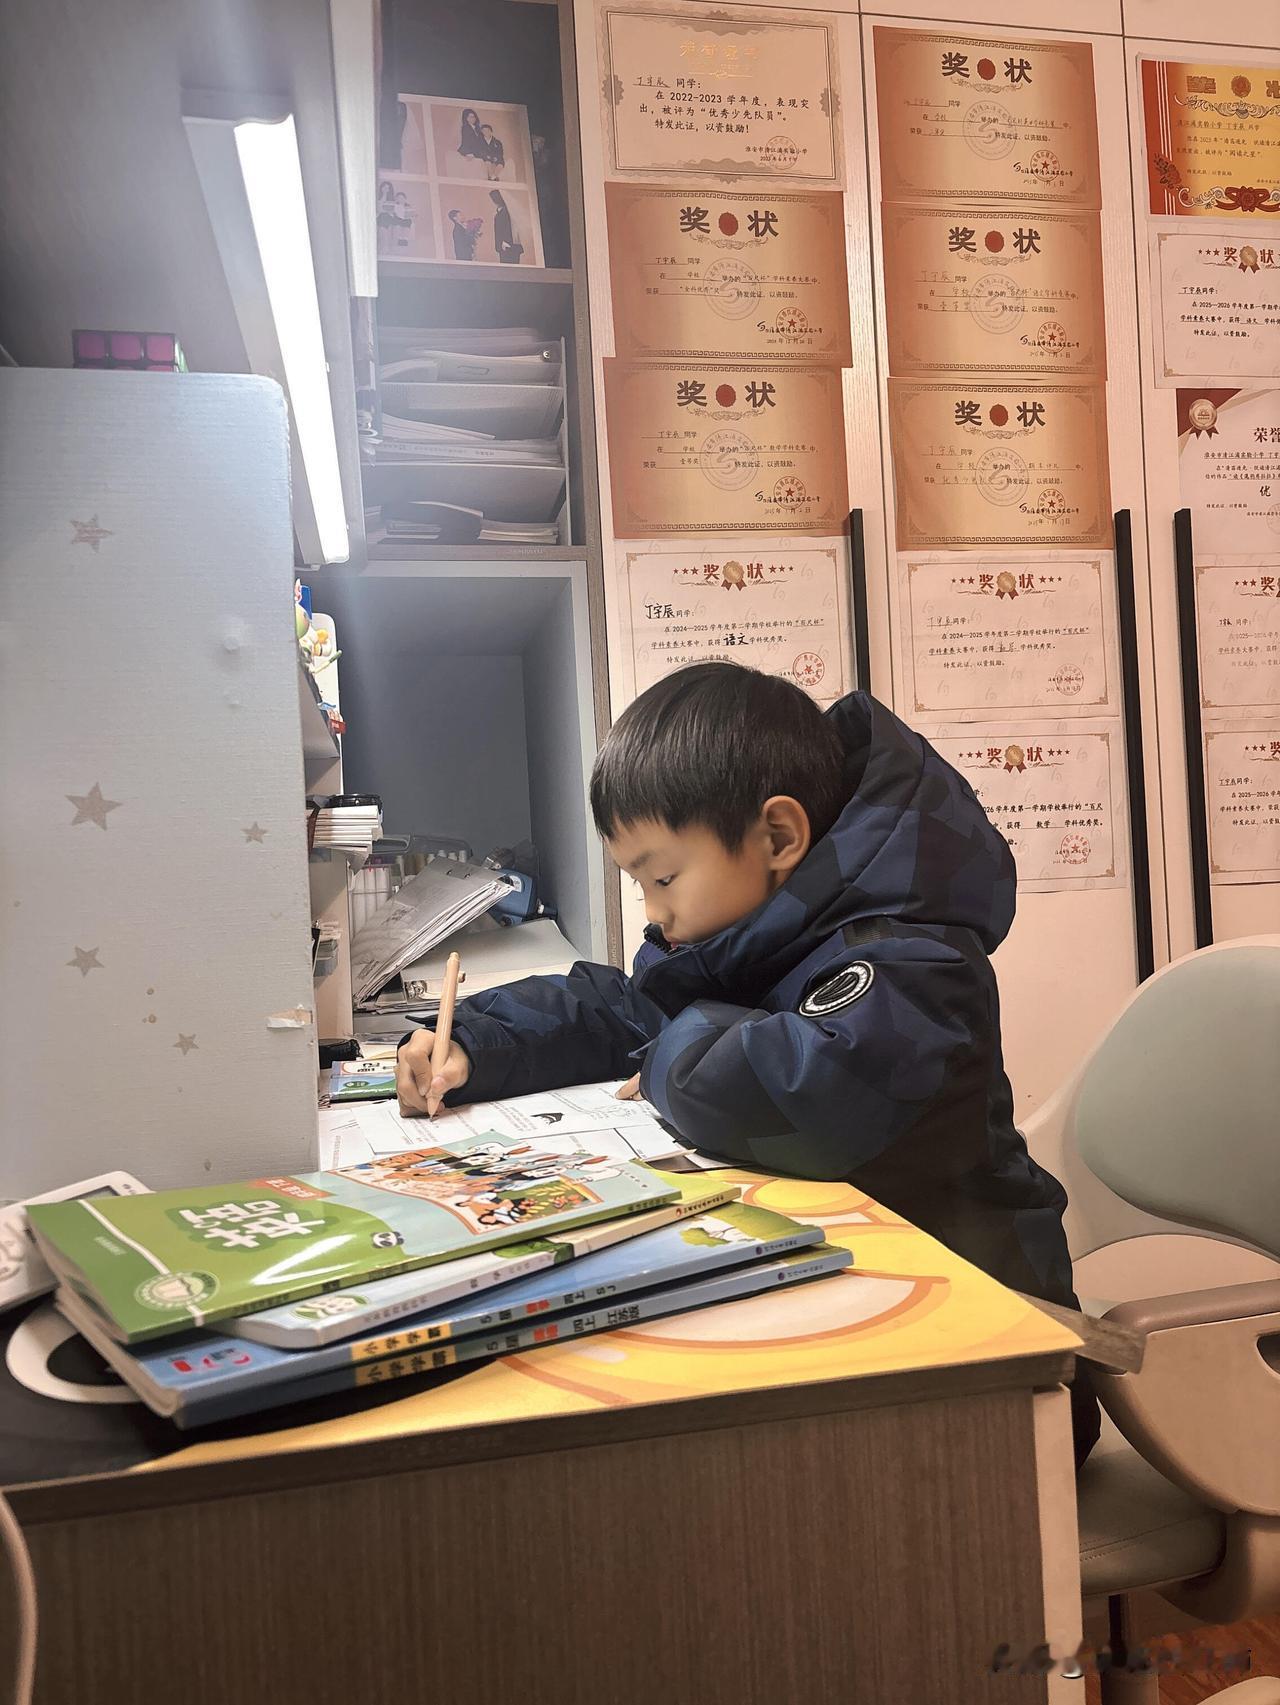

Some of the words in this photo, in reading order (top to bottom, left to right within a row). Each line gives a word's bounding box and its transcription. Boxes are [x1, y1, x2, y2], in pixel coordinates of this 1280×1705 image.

[723, 633, 749, 646] 语文
[179, 1200, 325, 1248] 英语
[608, 1304, 640, 1324] 江苏版
